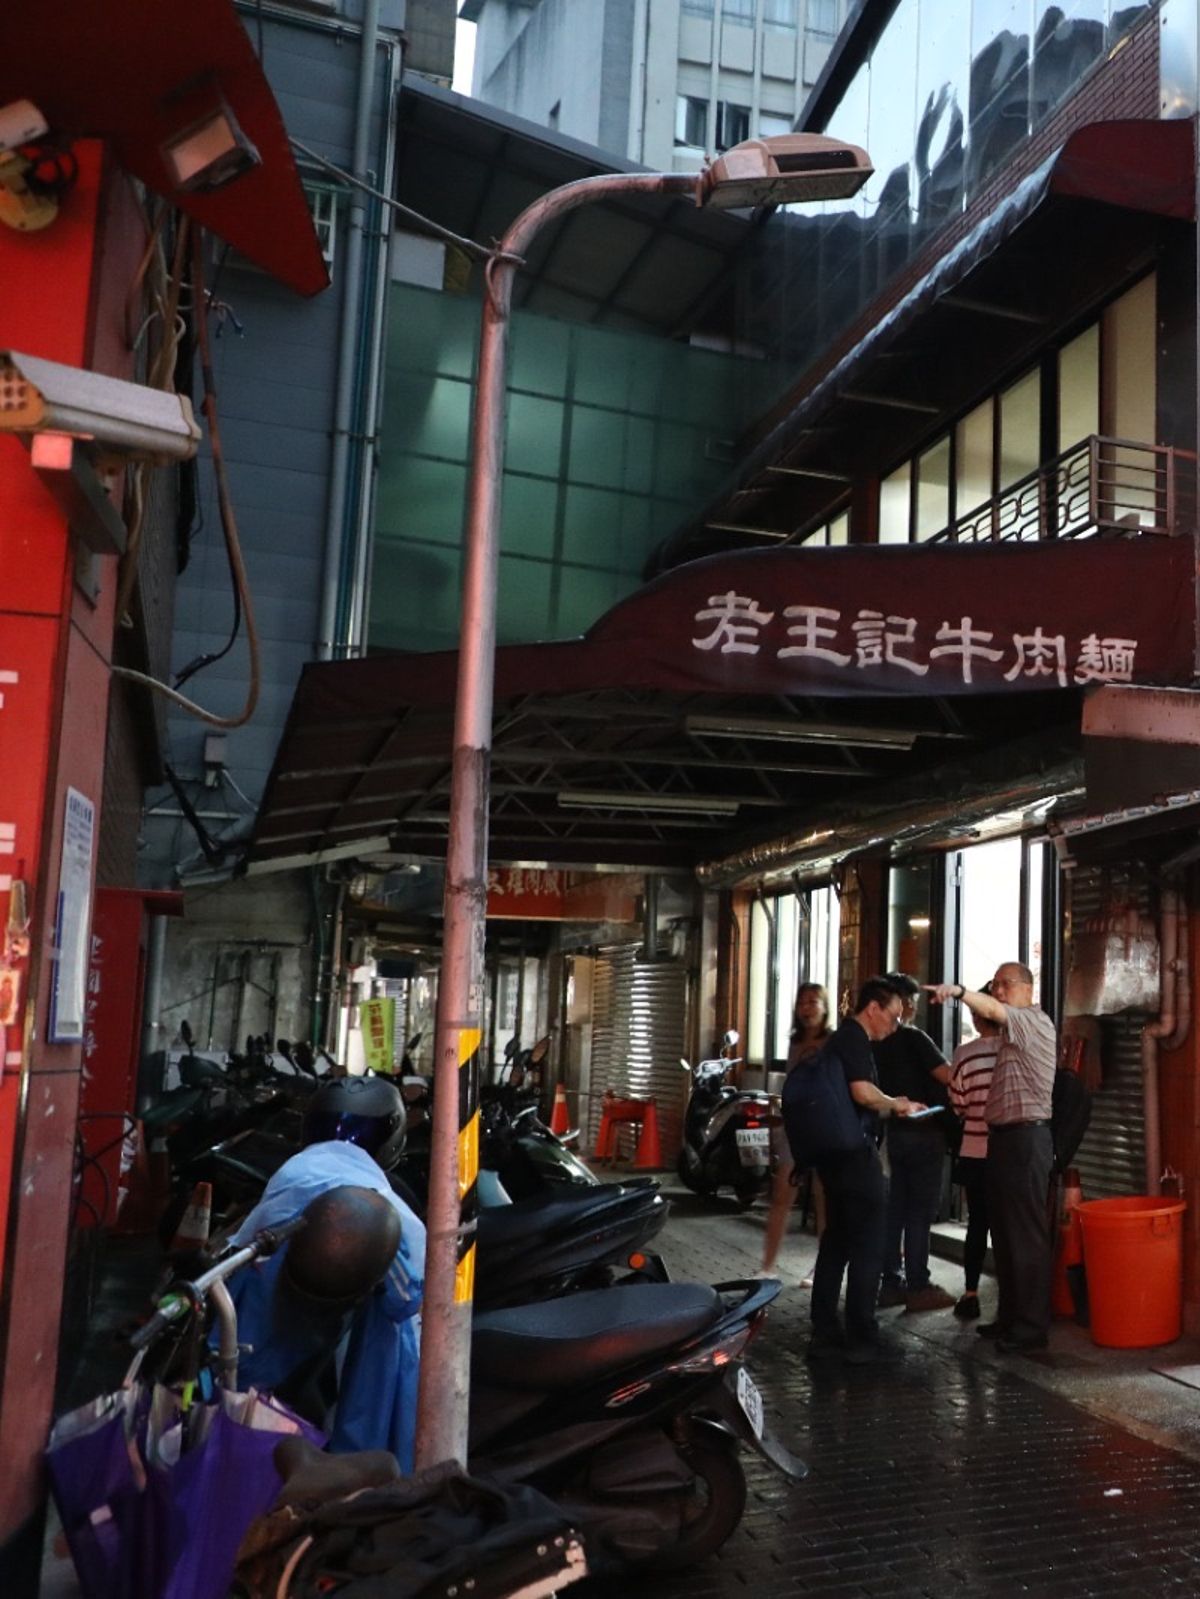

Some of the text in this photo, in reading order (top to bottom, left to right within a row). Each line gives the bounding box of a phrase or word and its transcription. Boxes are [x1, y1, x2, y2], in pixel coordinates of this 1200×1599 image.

[692, 590, 1138, 687] 老王記牛肉麵
